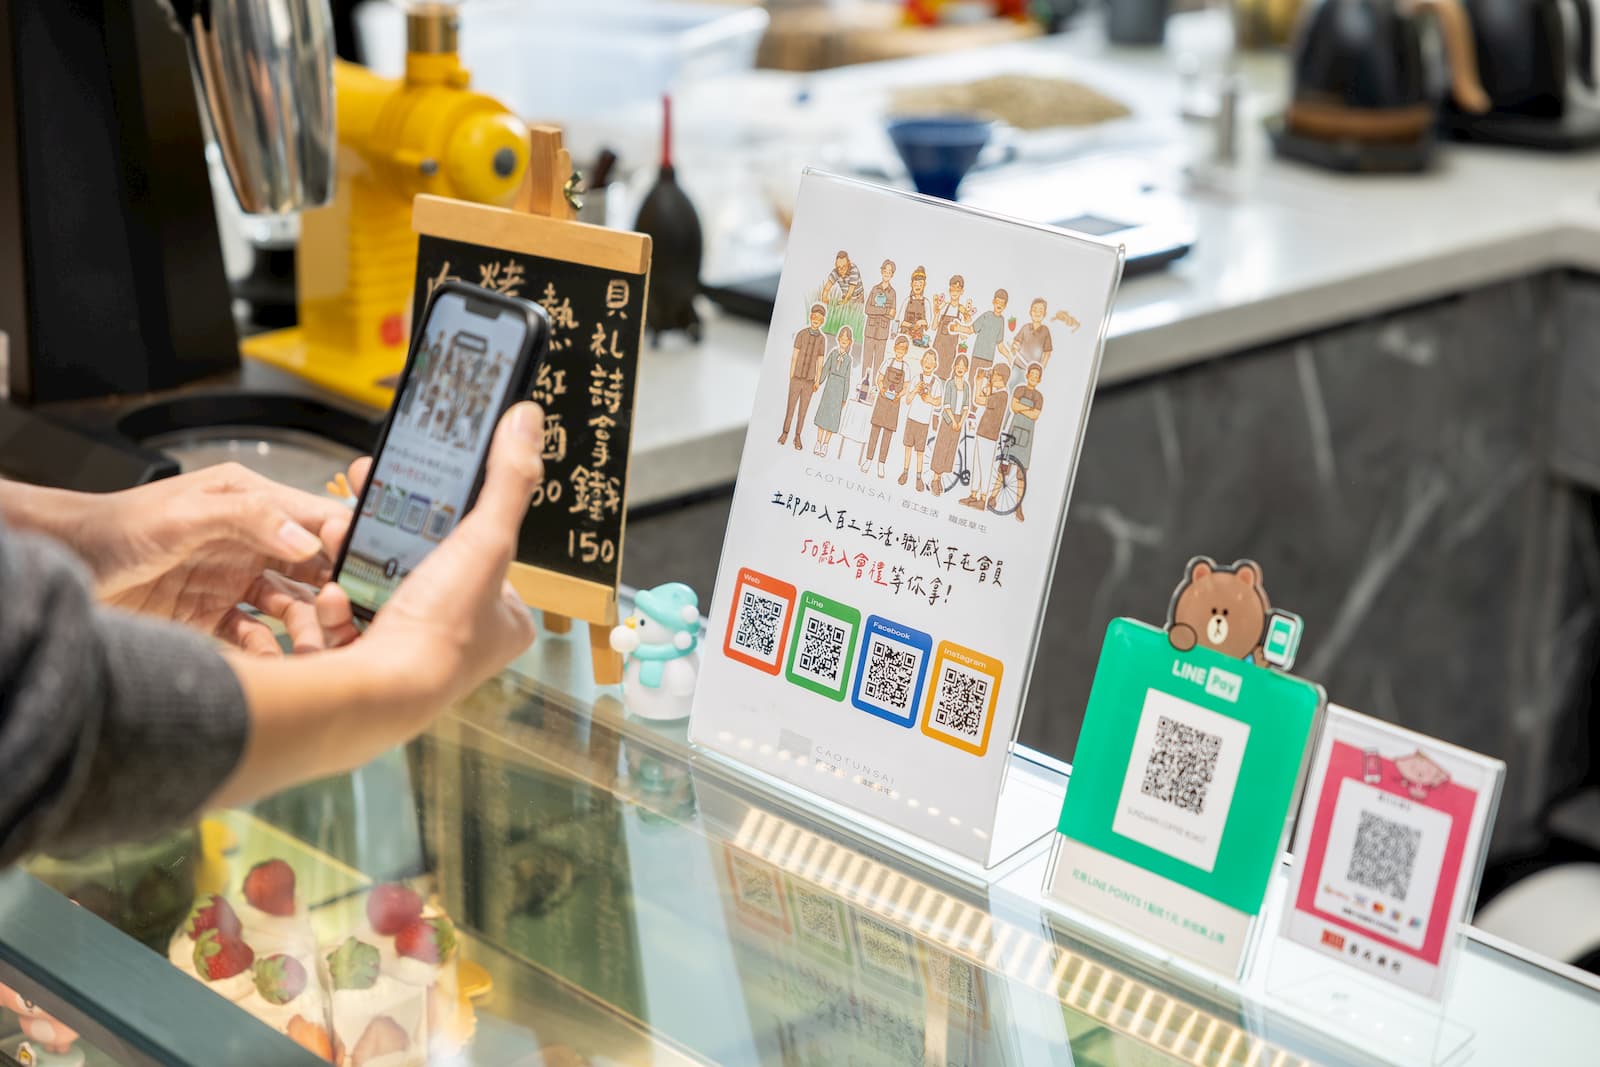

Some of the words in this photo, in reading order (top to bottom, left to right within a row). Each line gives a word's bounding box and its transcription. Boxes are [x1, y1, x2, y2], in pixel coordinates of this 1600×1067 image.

[805, 467, 892, 503] CAOTUNSAI
[568, 529, 615, 563] 150
[743, 573, 761, 585] Web
[805, 595, 824, 609] Line
[873, 621, 911, 640] Facebook
[943, 647, 987, 669] Instagram
[1172, 659, 1207, 686] LINE
[815, 745, 895, 785] CAOTUNSAI
